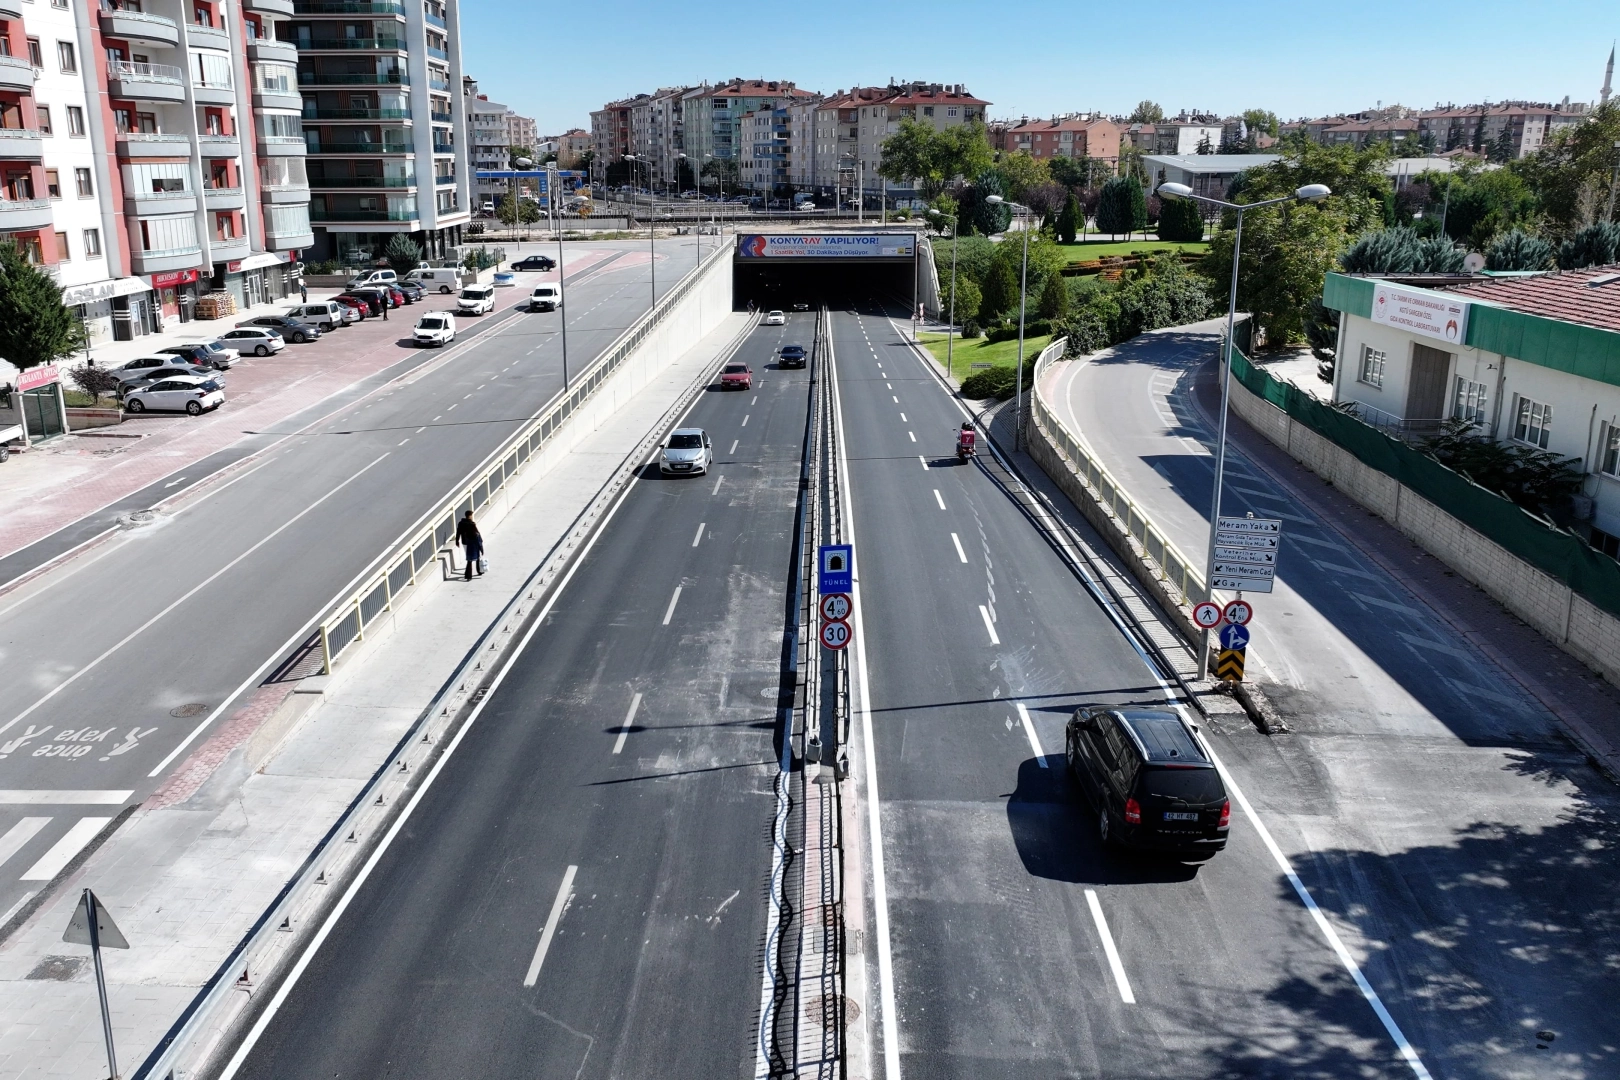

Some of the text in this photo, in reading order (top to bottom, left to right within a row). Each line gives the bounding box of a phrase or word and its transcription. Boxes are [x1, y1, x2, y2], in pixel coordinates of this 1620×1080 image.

[66, 284, 115, 304] ARSLAN
[1398, 318, 1413, 327] KONTROL
[1219, 521, 1247, 529] Meram
[827, 601, 835, 615] 4
[1229, 608, 1236, 620] 4
[826, 627, 846, 641] 30
[54, 726, 117, 742] yaya
[32, 744, 92, 762] önce
